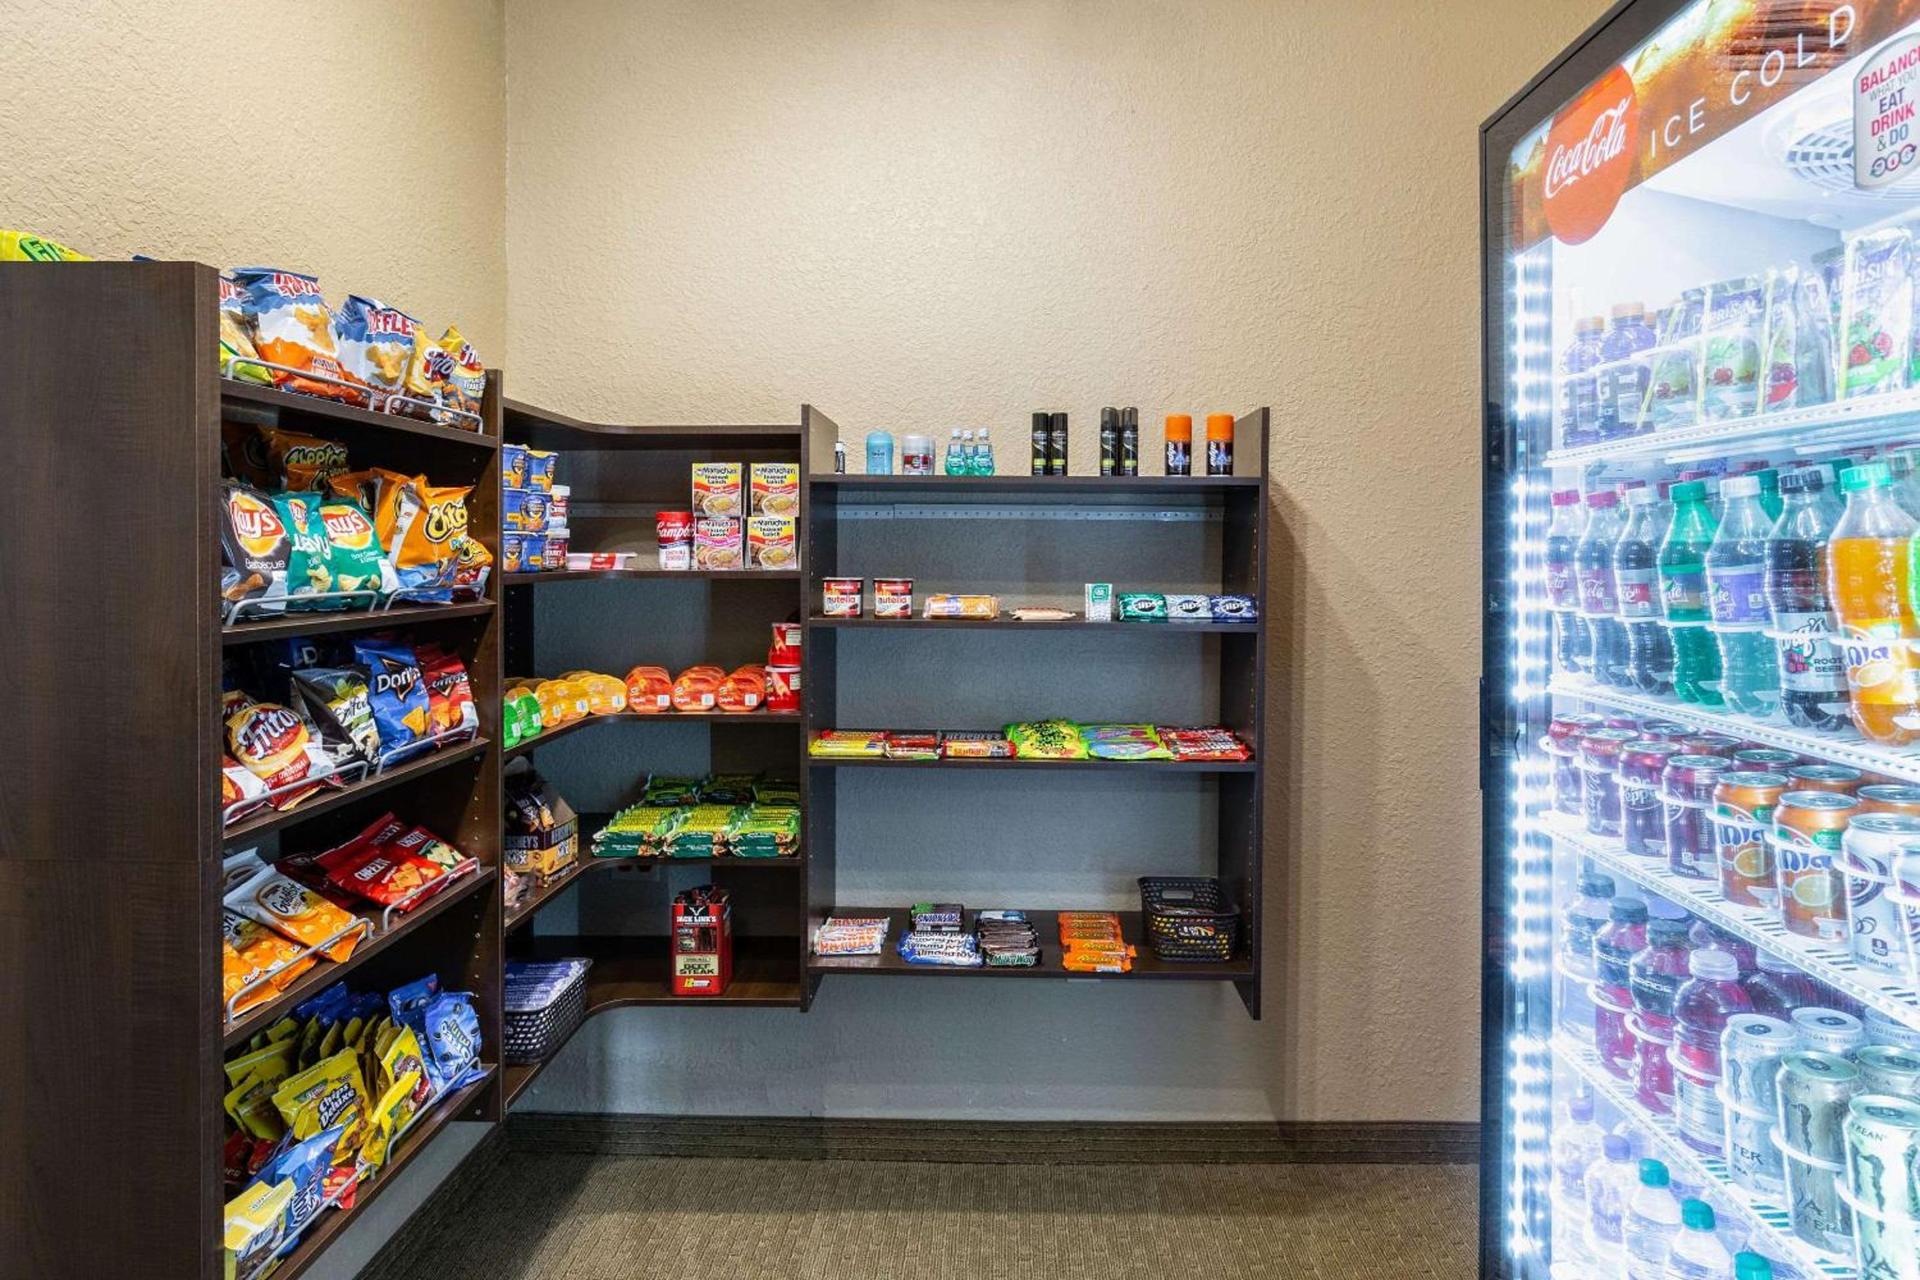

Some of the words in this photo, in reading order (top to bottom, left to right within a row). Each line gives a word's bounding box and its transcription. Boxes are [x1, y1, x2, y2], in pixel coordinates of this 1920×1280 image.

[1651, 98, 1705, 158] ICE
[1730, 4, 1856, 106] COLD
[1872, 101, 1915, 137] DRINK
[1880, 88, 1905, 114] EAT
[1545, 94, 1632, 199] Coca-Cola
[1877, 135, 1887, 152] &
[1890, 123, 1909, 146] DO
